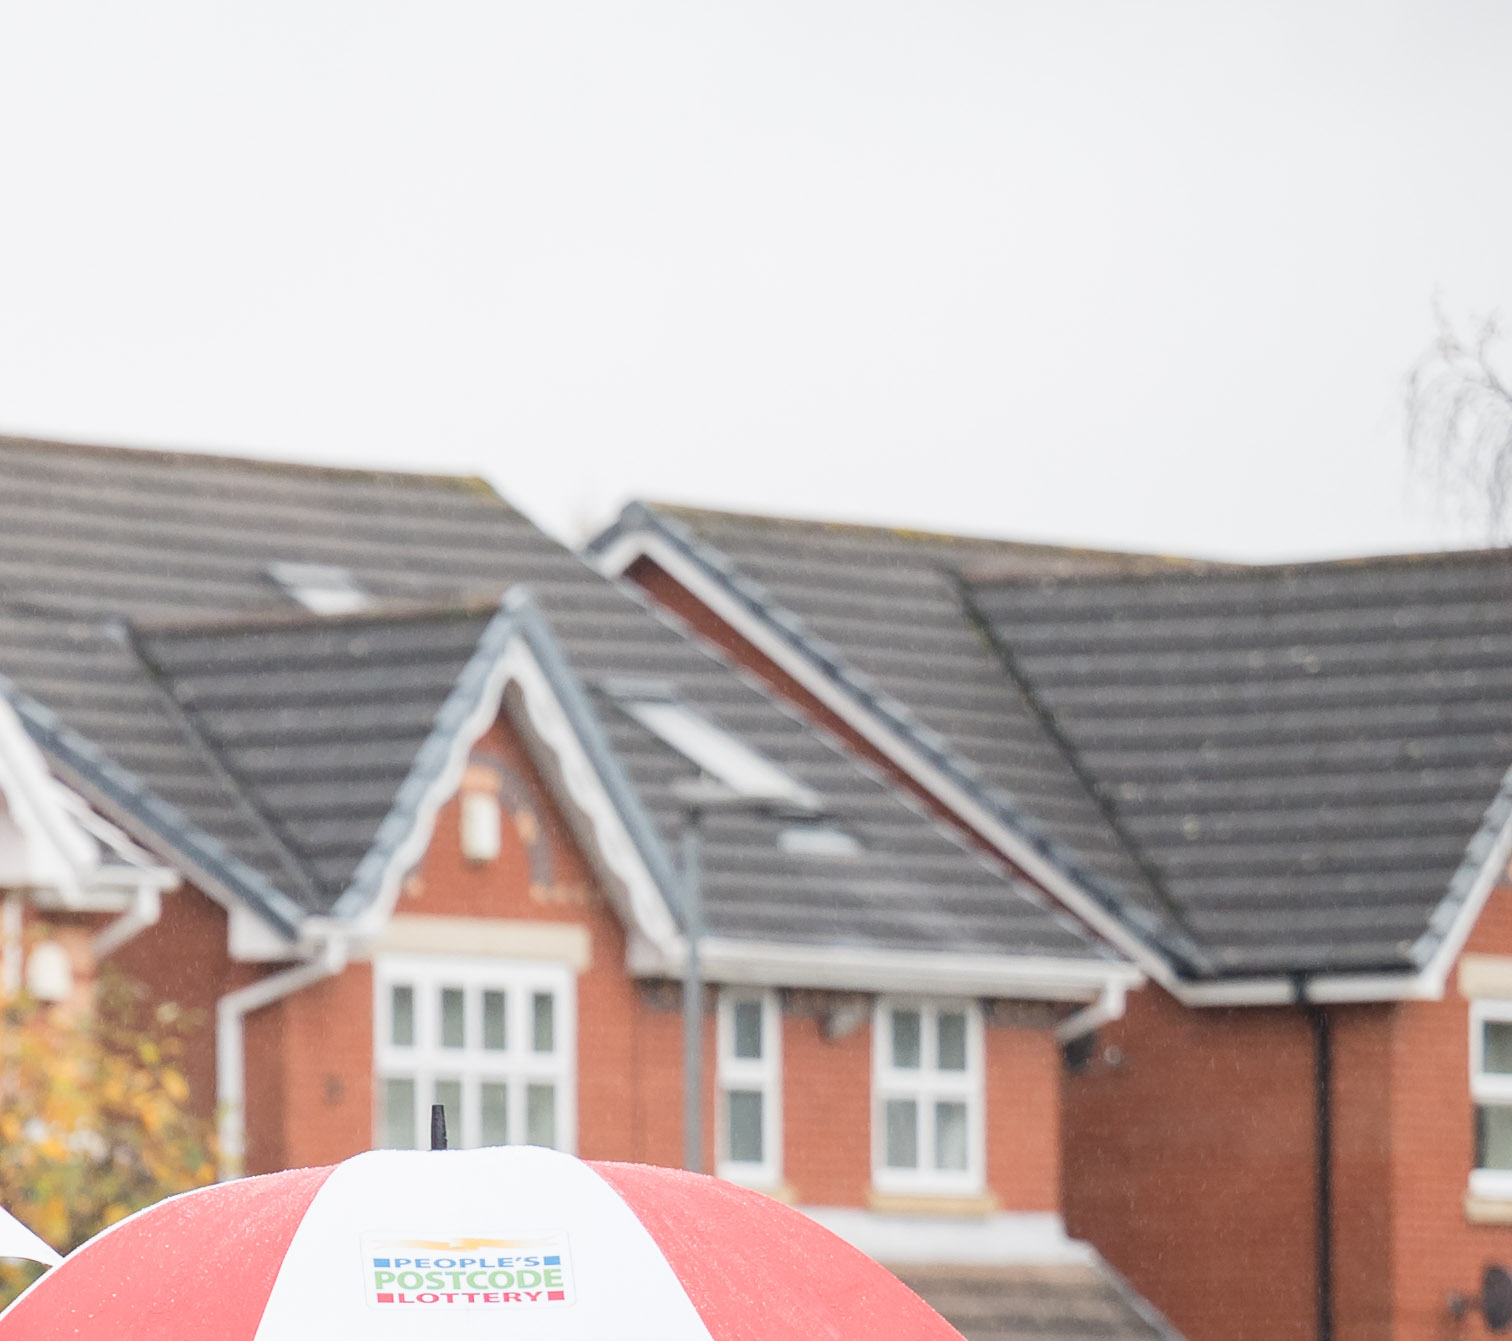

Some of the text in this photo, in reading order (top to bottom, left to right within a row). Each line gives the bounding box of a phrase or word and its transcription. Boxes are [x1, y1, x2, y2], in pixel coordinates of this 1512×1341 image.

[394, 1256, 540, 1268] PEOPLE'S
[374, 1269, 564, 1290] POSTCODE
[398, 1292, 543, 1303] LOTTERY
